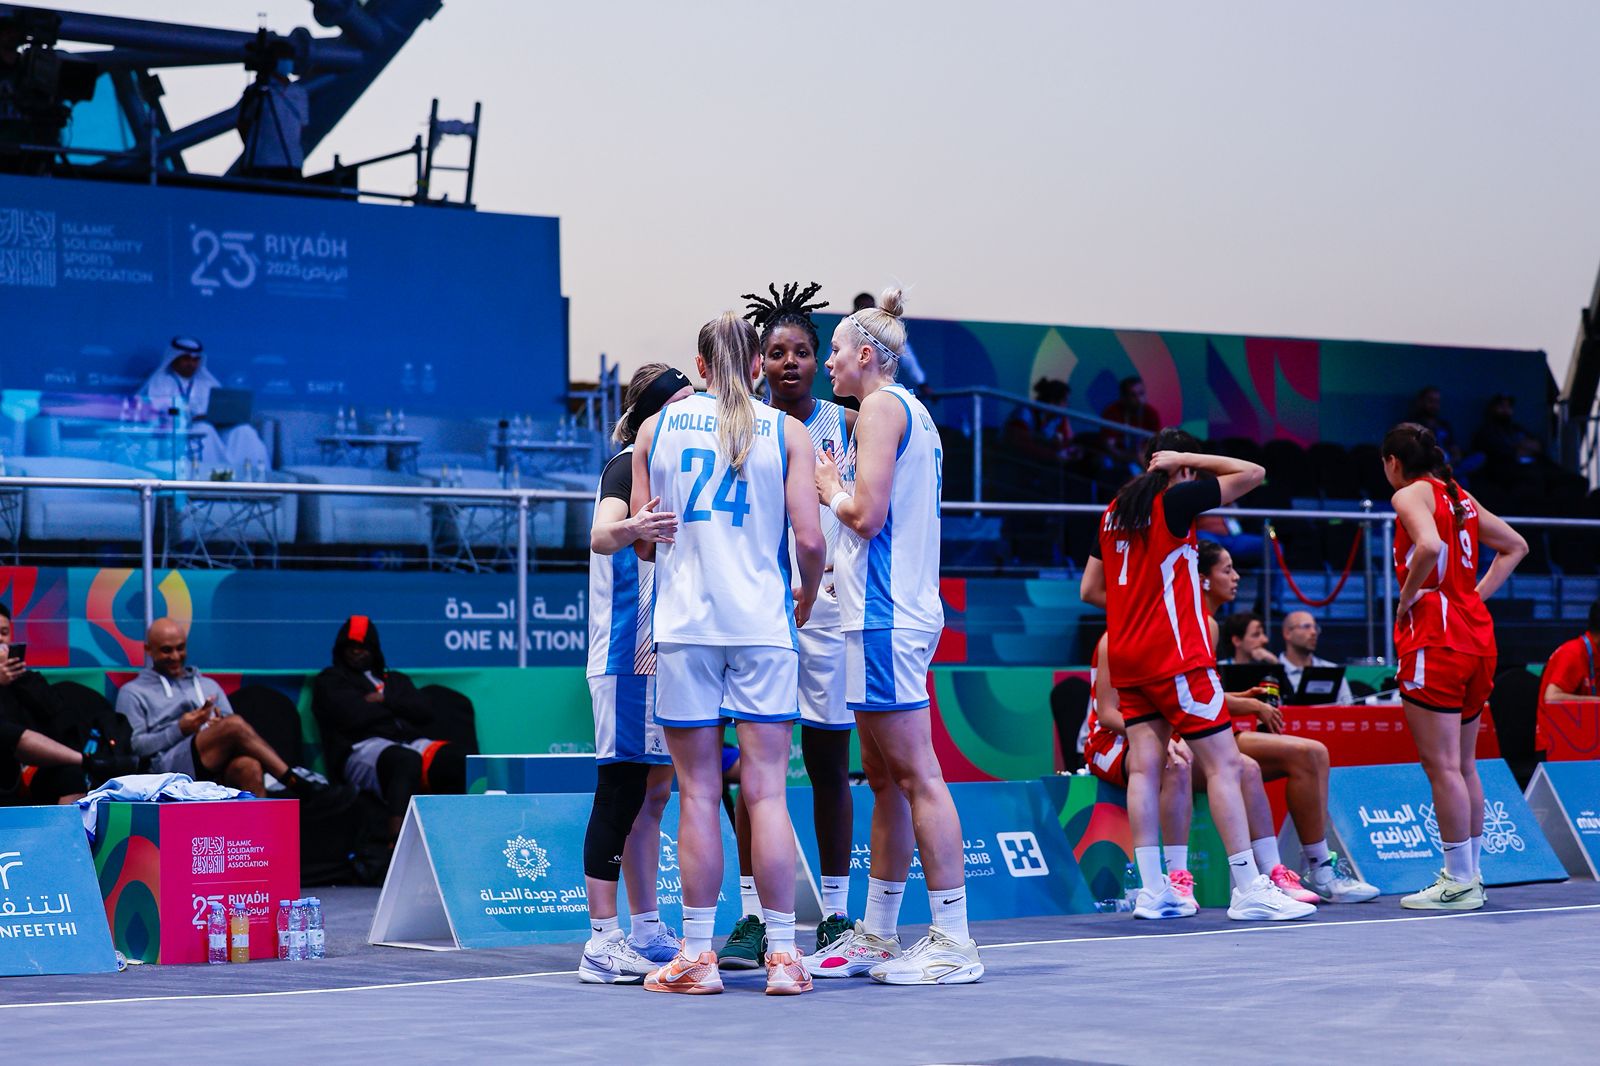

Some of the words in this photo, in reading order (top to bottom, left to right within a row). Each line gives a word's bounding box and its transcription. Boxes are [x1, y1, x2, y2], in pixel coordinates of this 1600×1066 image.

[265, 230, 347, 260] RIYADH
[681, 448, 750, 527] 24
[1459, 529, 1473, 569] 9
[1116, 540, 1130, 585] 7
[532, 590, 584, 620] أمة
[444, 630, 492, 650] ONE
[1359, 804, 1416, 827] المسار
[1370, 825, 1426, 849] الرياضي
[227, 846, 265, 854] SOLIDARITY
[227, 860, 269, 868] ASSOCIATION
[228, 891, 269, 904] RIYADH
[480, 888, 523, 903] الحياة
[524, 888, 557, 903] جودة
[485, 906, 521, 915] QUALITY
[524, 906, 536, 914] OF
[537, 905, 556, 914] LIFE
[557, 904, 590, 913] PROGR
